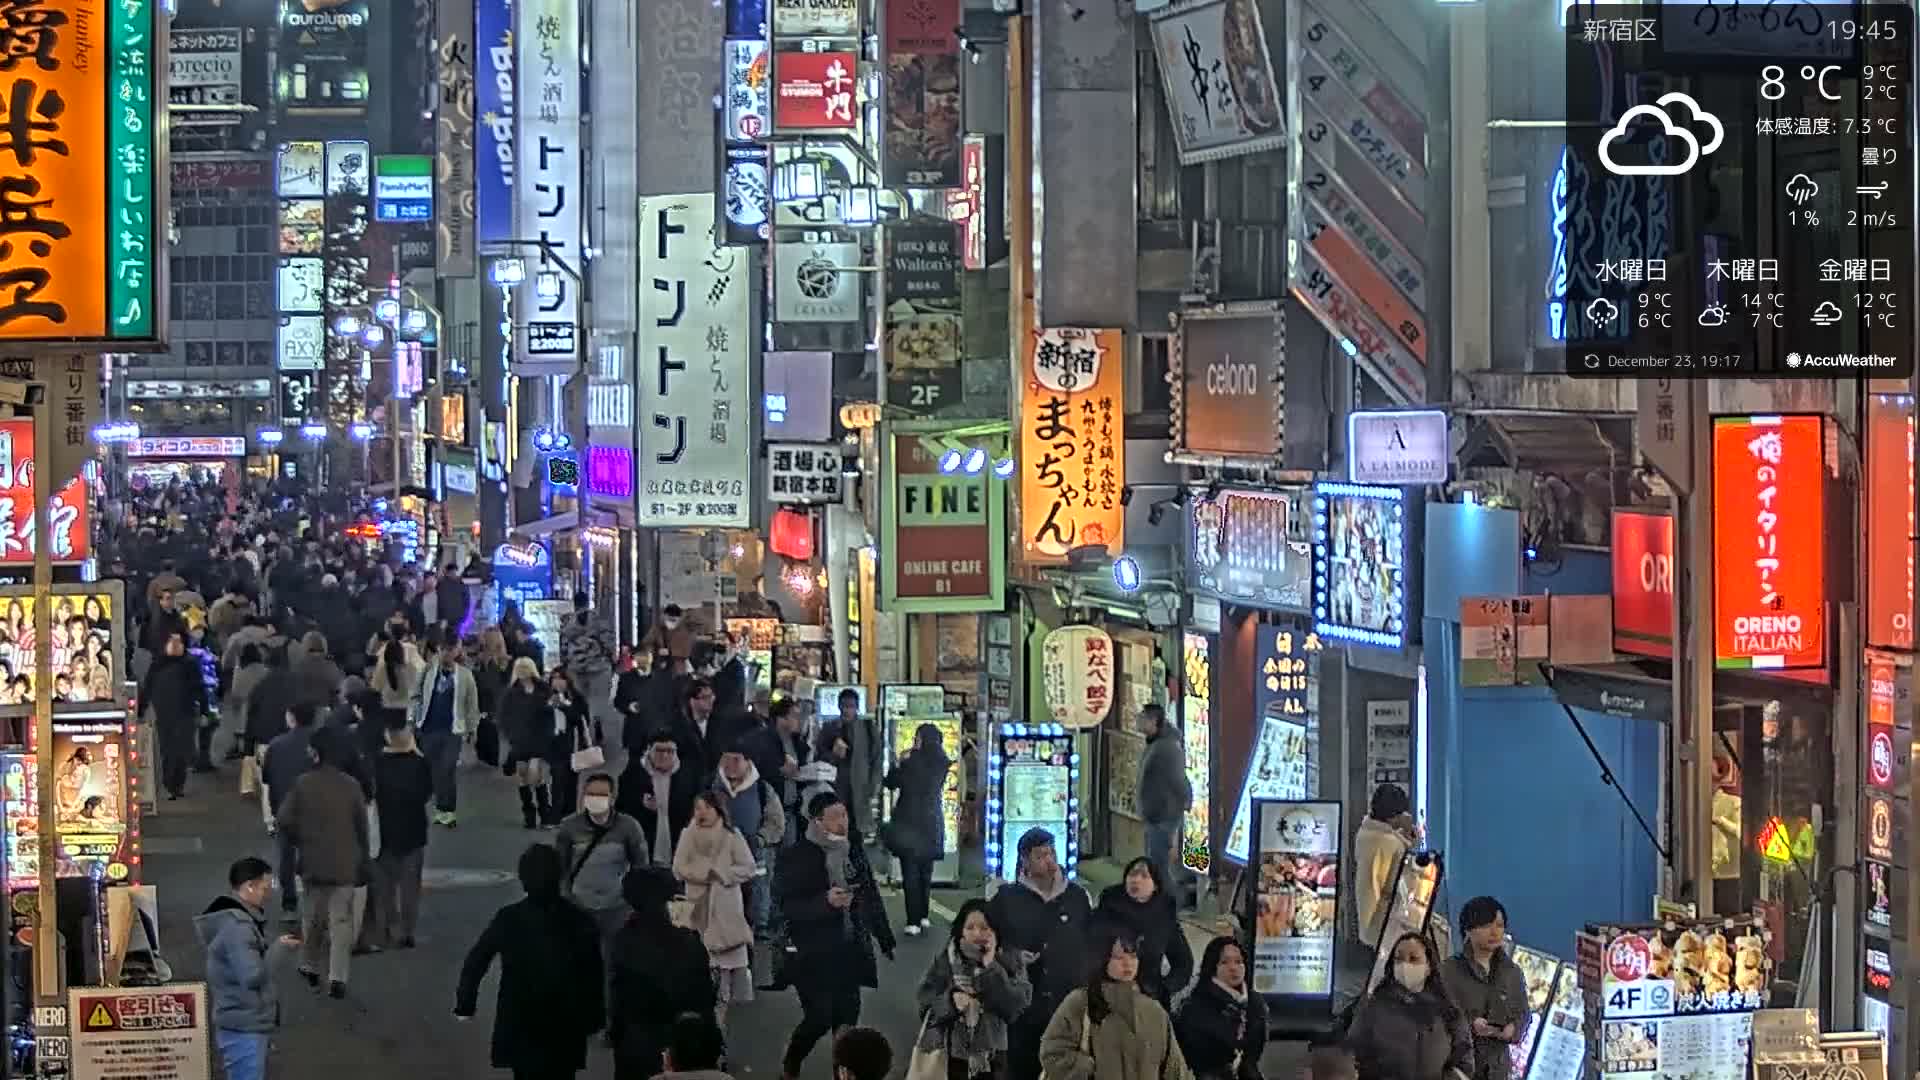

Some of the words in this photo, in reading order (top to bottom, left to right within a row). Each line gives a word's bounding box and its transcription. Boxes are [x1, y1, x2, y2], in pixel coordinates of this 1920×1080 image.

[1307, 23, 1328, 42] 5
[823, 58, 853, 121] 牛門
[1308, 75, 1327, 91] 4
[1308, 123, 1327, 142] 3
[653, 209, 687, 465] トントン
[1037, 340, 1097, 373] 新宿
[1207, 352, 1257, 396] celona
[911, 385, 940, 405] 2F
[773, 450, 839, 473] 酒場心
[1034, 396, 1079, 546] まっちゃん
[772, 475, 838, 495] 新宿本店
[904, 485, 981, 514] FINE
[904, 560, 949, 575] ONLINE
[951, 559, 982, 574] CAFE
[1734, 615, 1802, 634] ORENO
[1734, 634, 1802, 653] ITALIAN
[1608, 988, 1642, 1010] 4F
[35, 1007, 66, 1026] NERO
[37, 1037, 68, 1057] NERO
